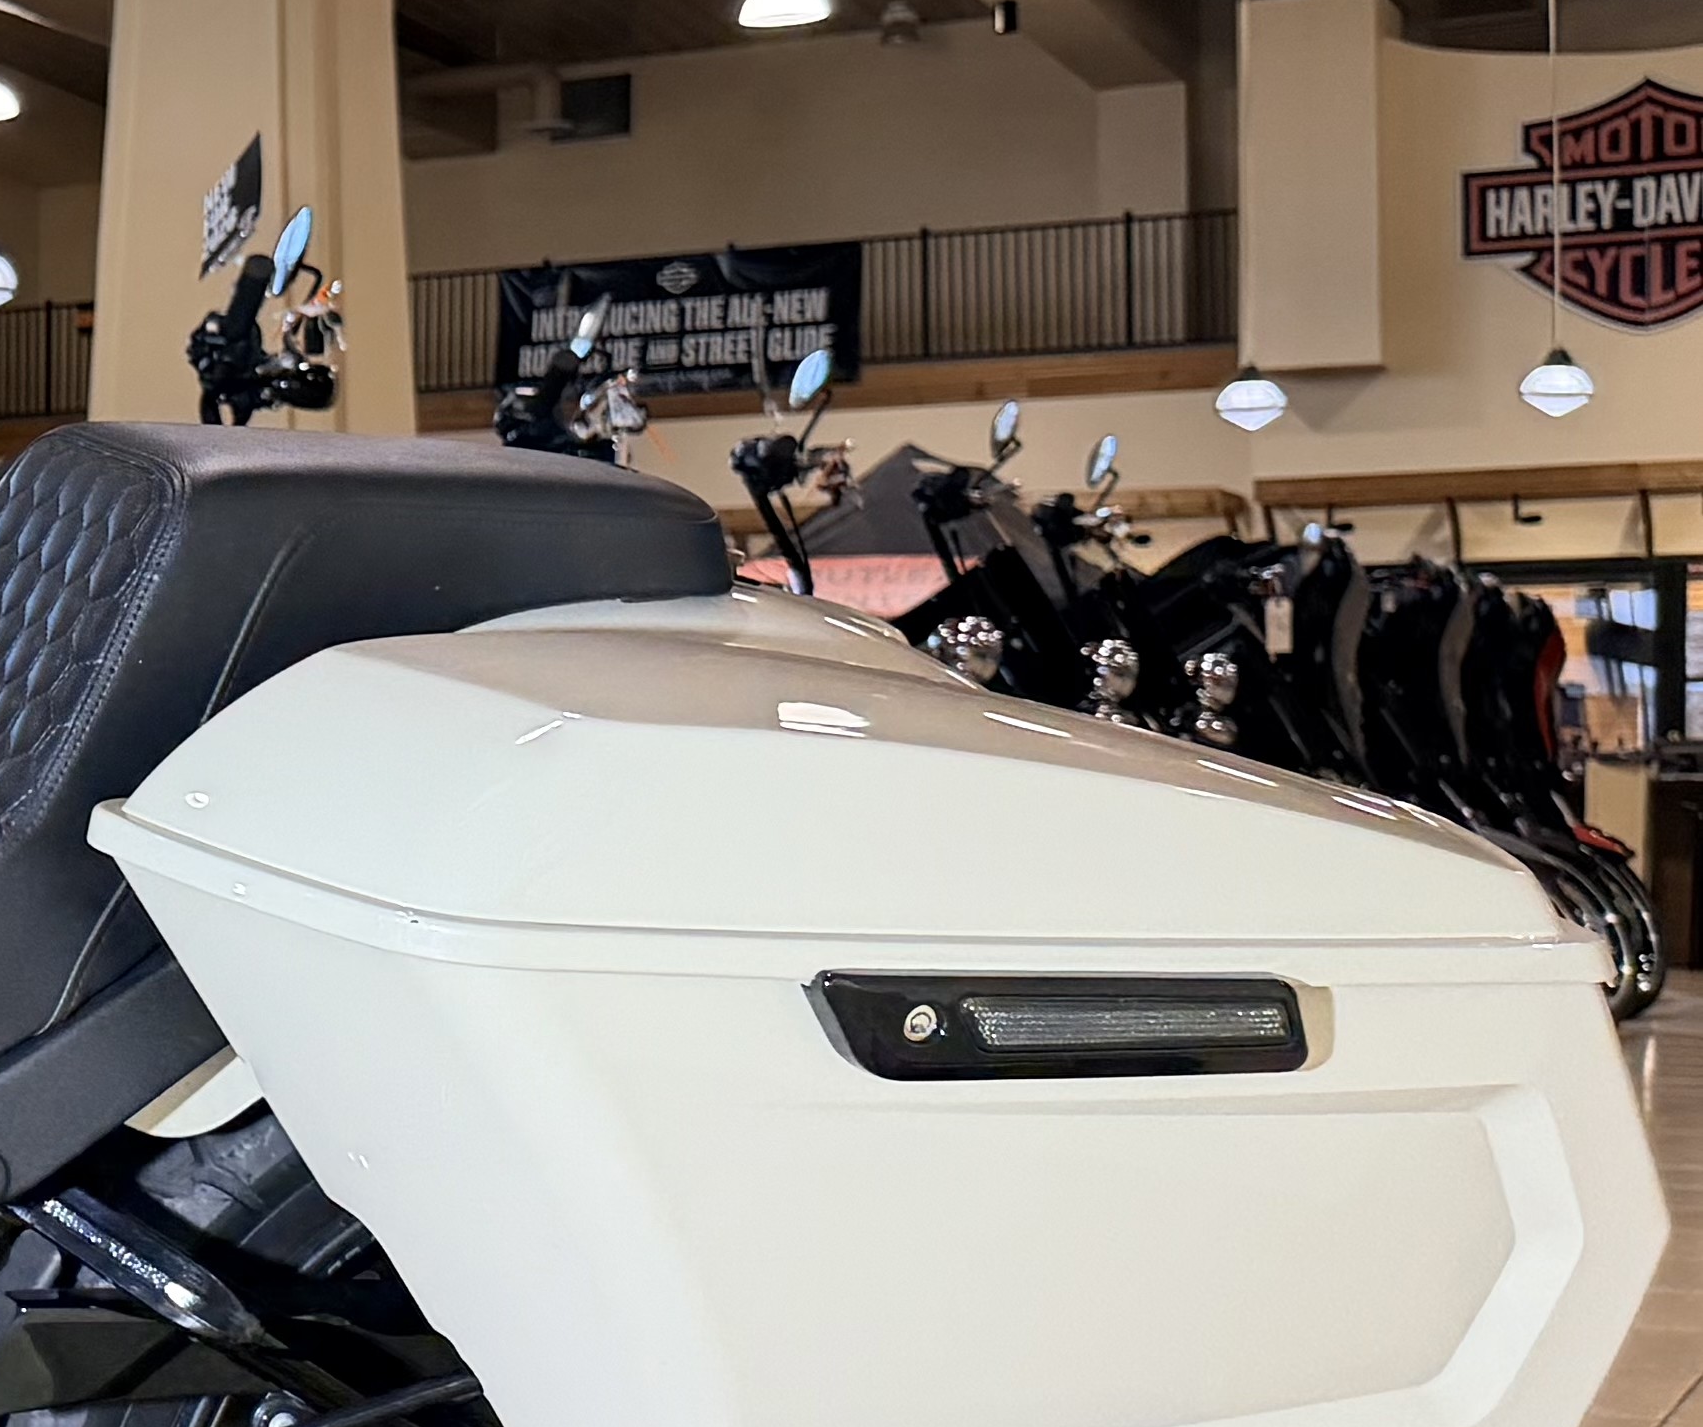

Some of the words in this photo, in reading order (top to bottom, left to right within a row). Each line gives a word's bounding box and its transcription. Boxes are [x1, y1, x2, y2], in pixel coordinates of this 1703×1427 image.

[1561, 102, 1703, 165] MOTO
[1485, 172, 1703, 239] HARLEY-DAV
[684, 295, 726, 330] THE
[681, 328, 757, 368] STREET
